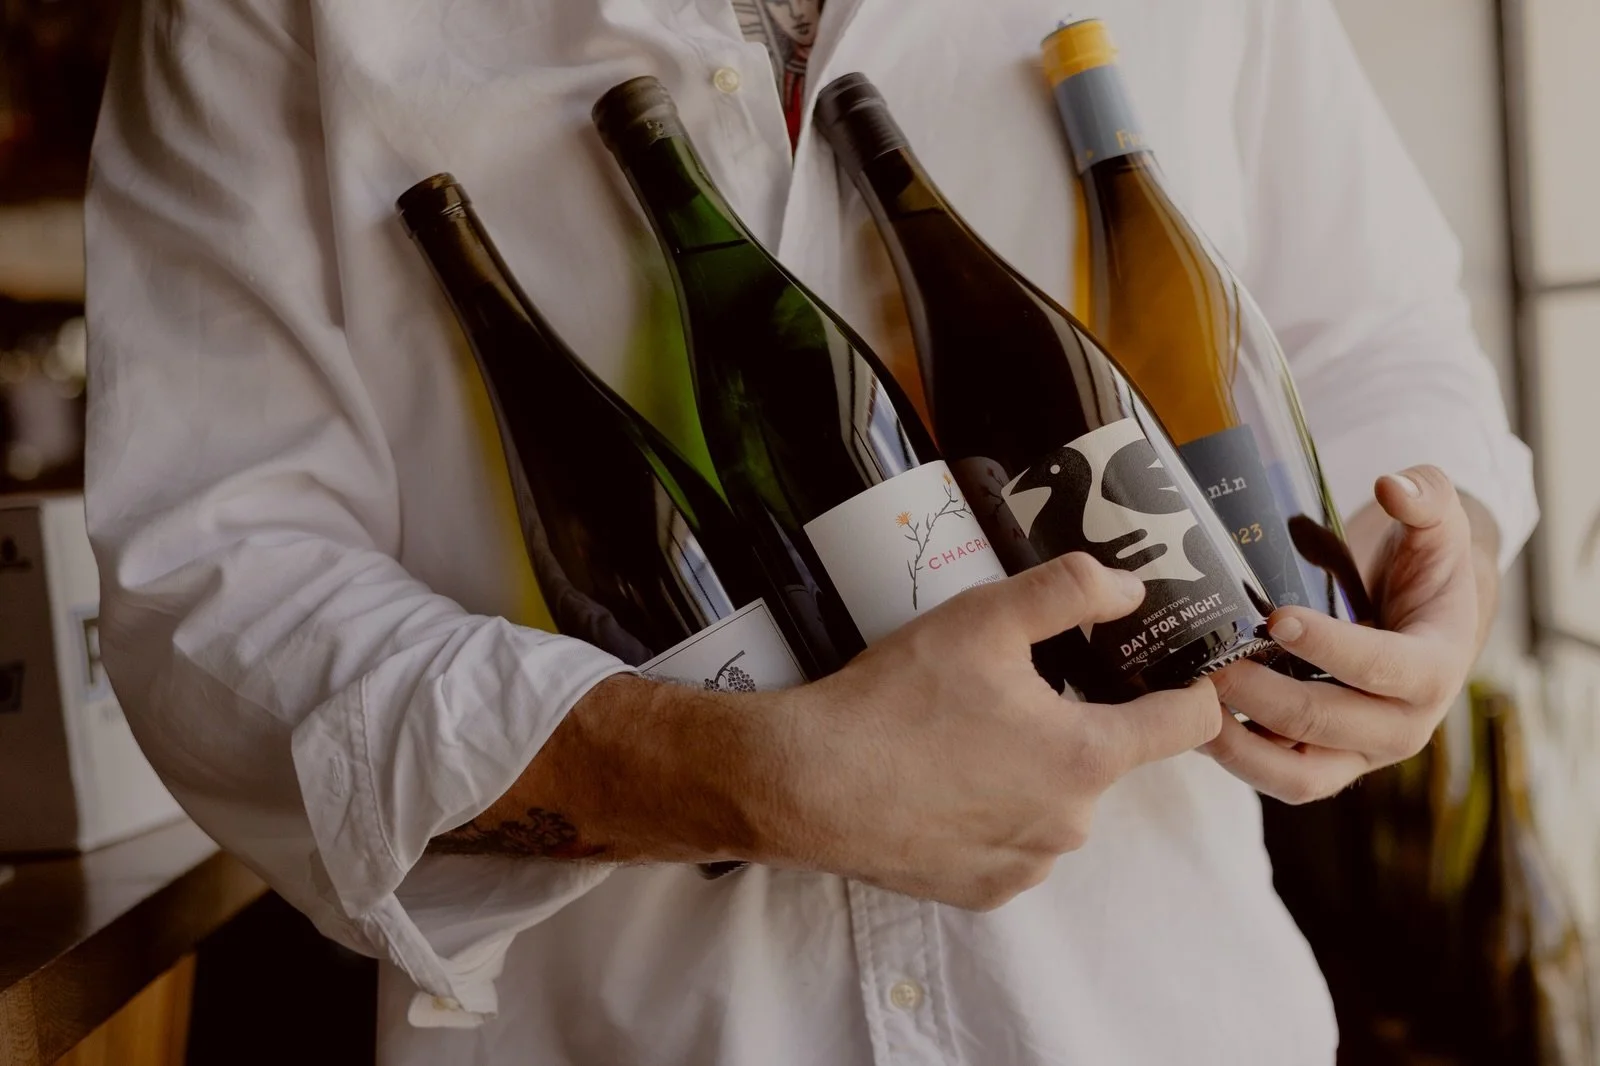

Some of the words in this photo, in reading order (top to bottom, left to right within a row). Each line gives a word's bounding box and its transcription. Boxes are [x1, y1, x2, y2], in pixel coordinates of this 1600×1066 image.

[1207, 476, 1247, 498] nin
[1231, 522, 1263, 544] 23
[928, 537, 990, 570] CHACRA
[1142, 607, 1167, 625] BASKET
[1167, 595, 1191, 610] TOWN
[1190, 610, 1222, 630] ADELAIDE
[1221, 603, 1239, 615] HILLS
[1119, 631, 1148, 657] DAY
[1150, 615, 1180, 639] FOR
[1179, 592, 1223, 622] NIGHT
[1120, 650, 1149, 671] VINTAGE
